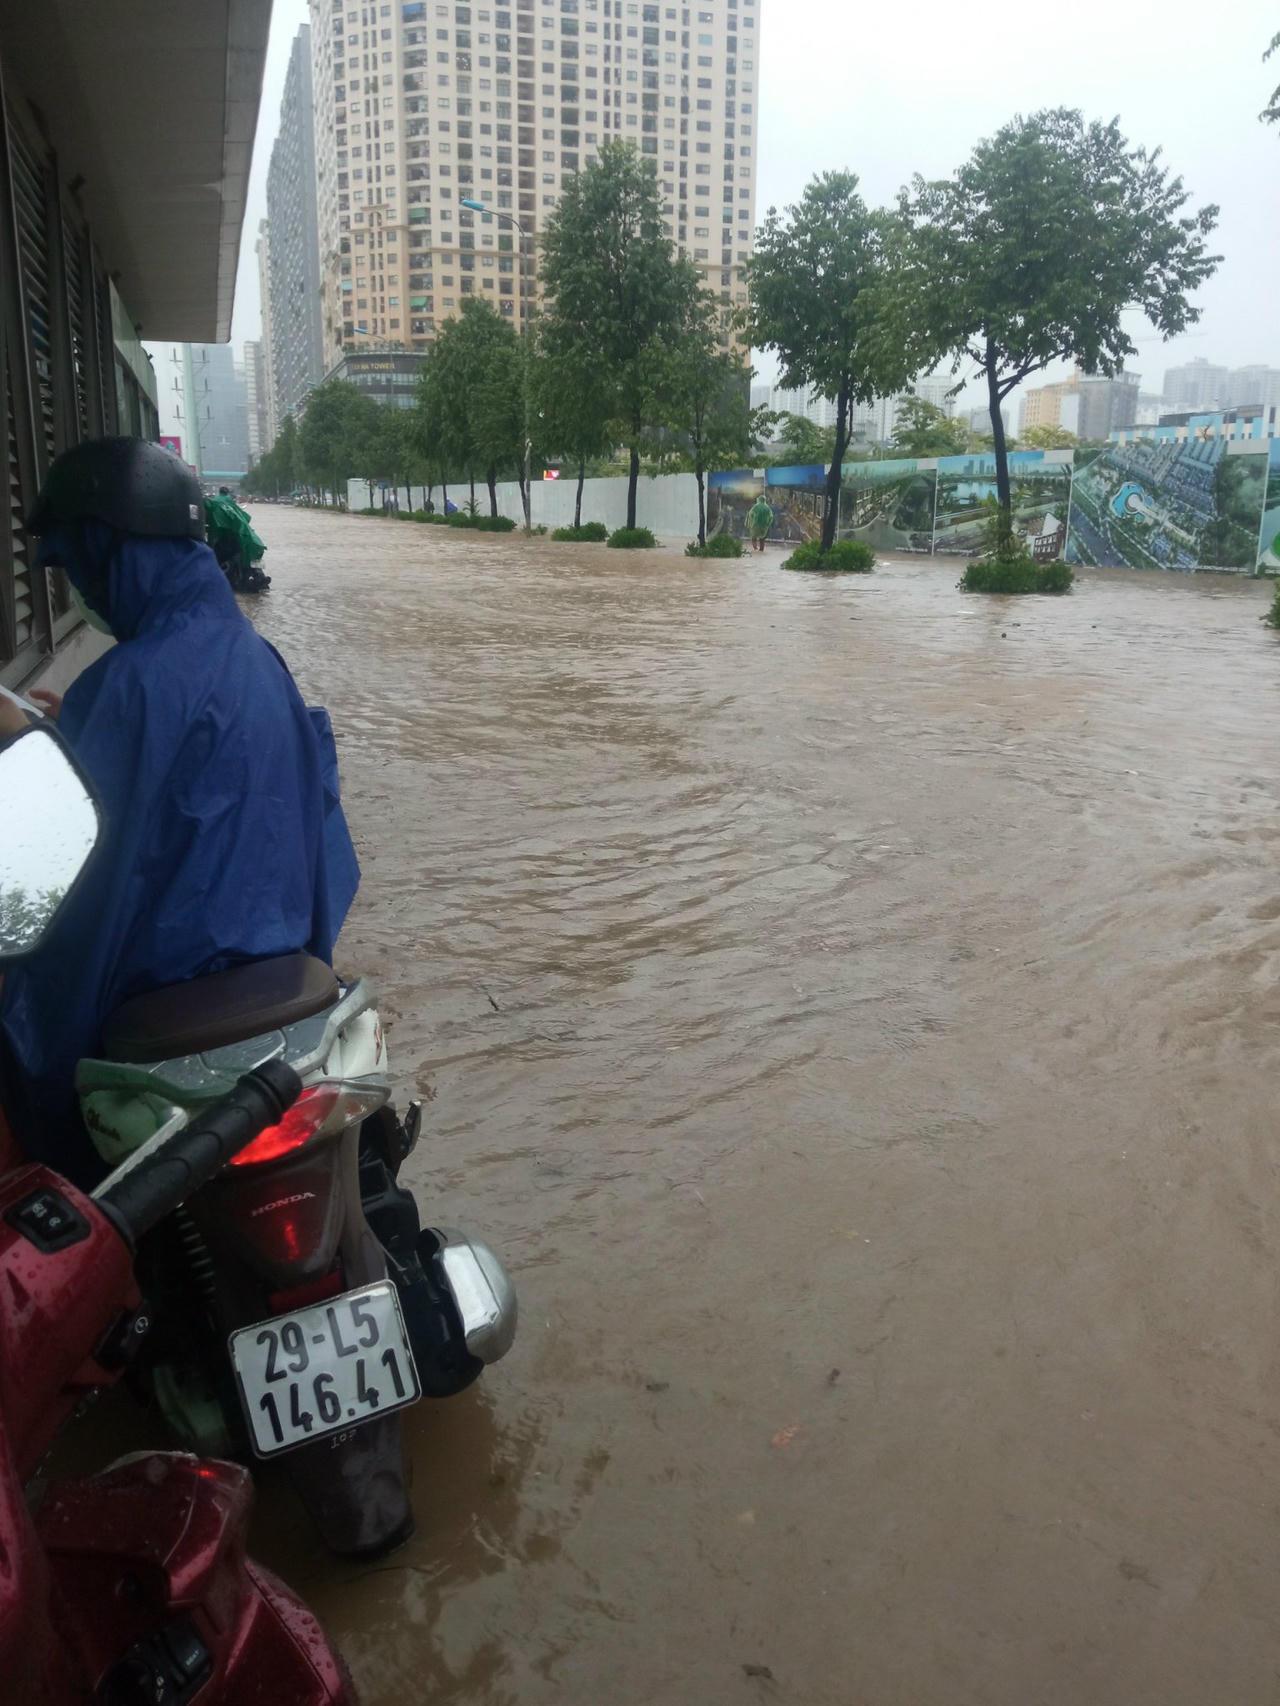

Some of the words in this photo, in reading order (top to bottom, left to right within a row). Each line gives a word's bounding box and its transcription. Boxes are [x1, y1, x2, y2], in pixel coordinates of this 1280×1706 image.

[251, 1191, 316, 1217] HONDA
[256, 1296, 380, 1384] 29-L5
[260, 1347, 406, 1443] 146.41
